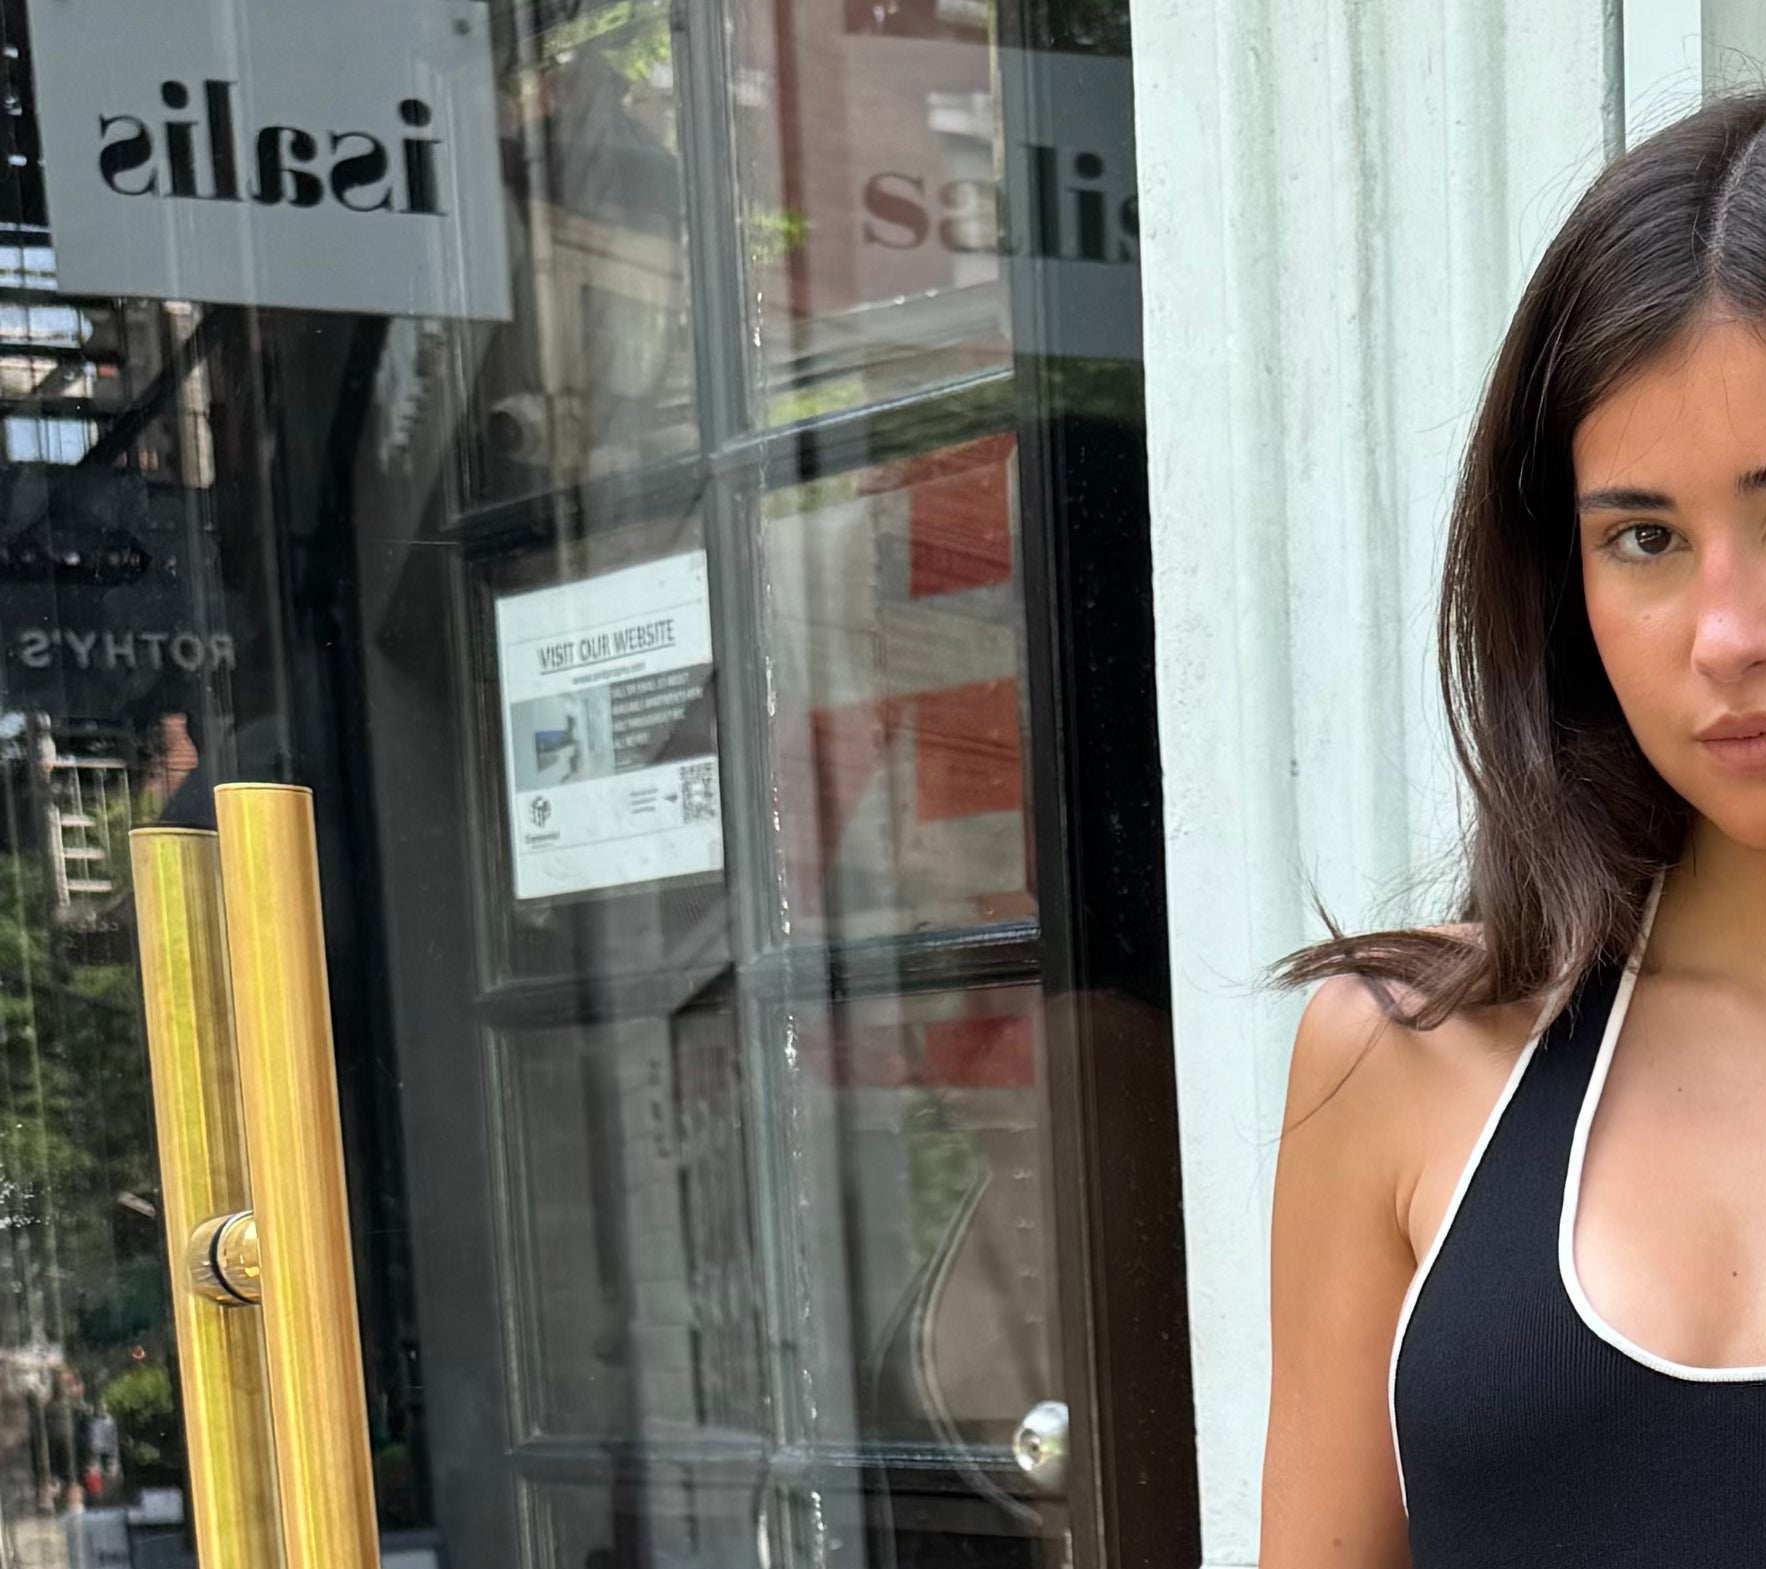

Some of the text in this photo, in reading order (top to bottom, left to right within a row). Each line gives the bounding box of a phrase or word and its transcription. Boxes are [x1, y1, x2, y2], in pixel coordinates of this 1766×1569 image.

[539, 618, 675, 669] VISIT OUR WEBSITE
